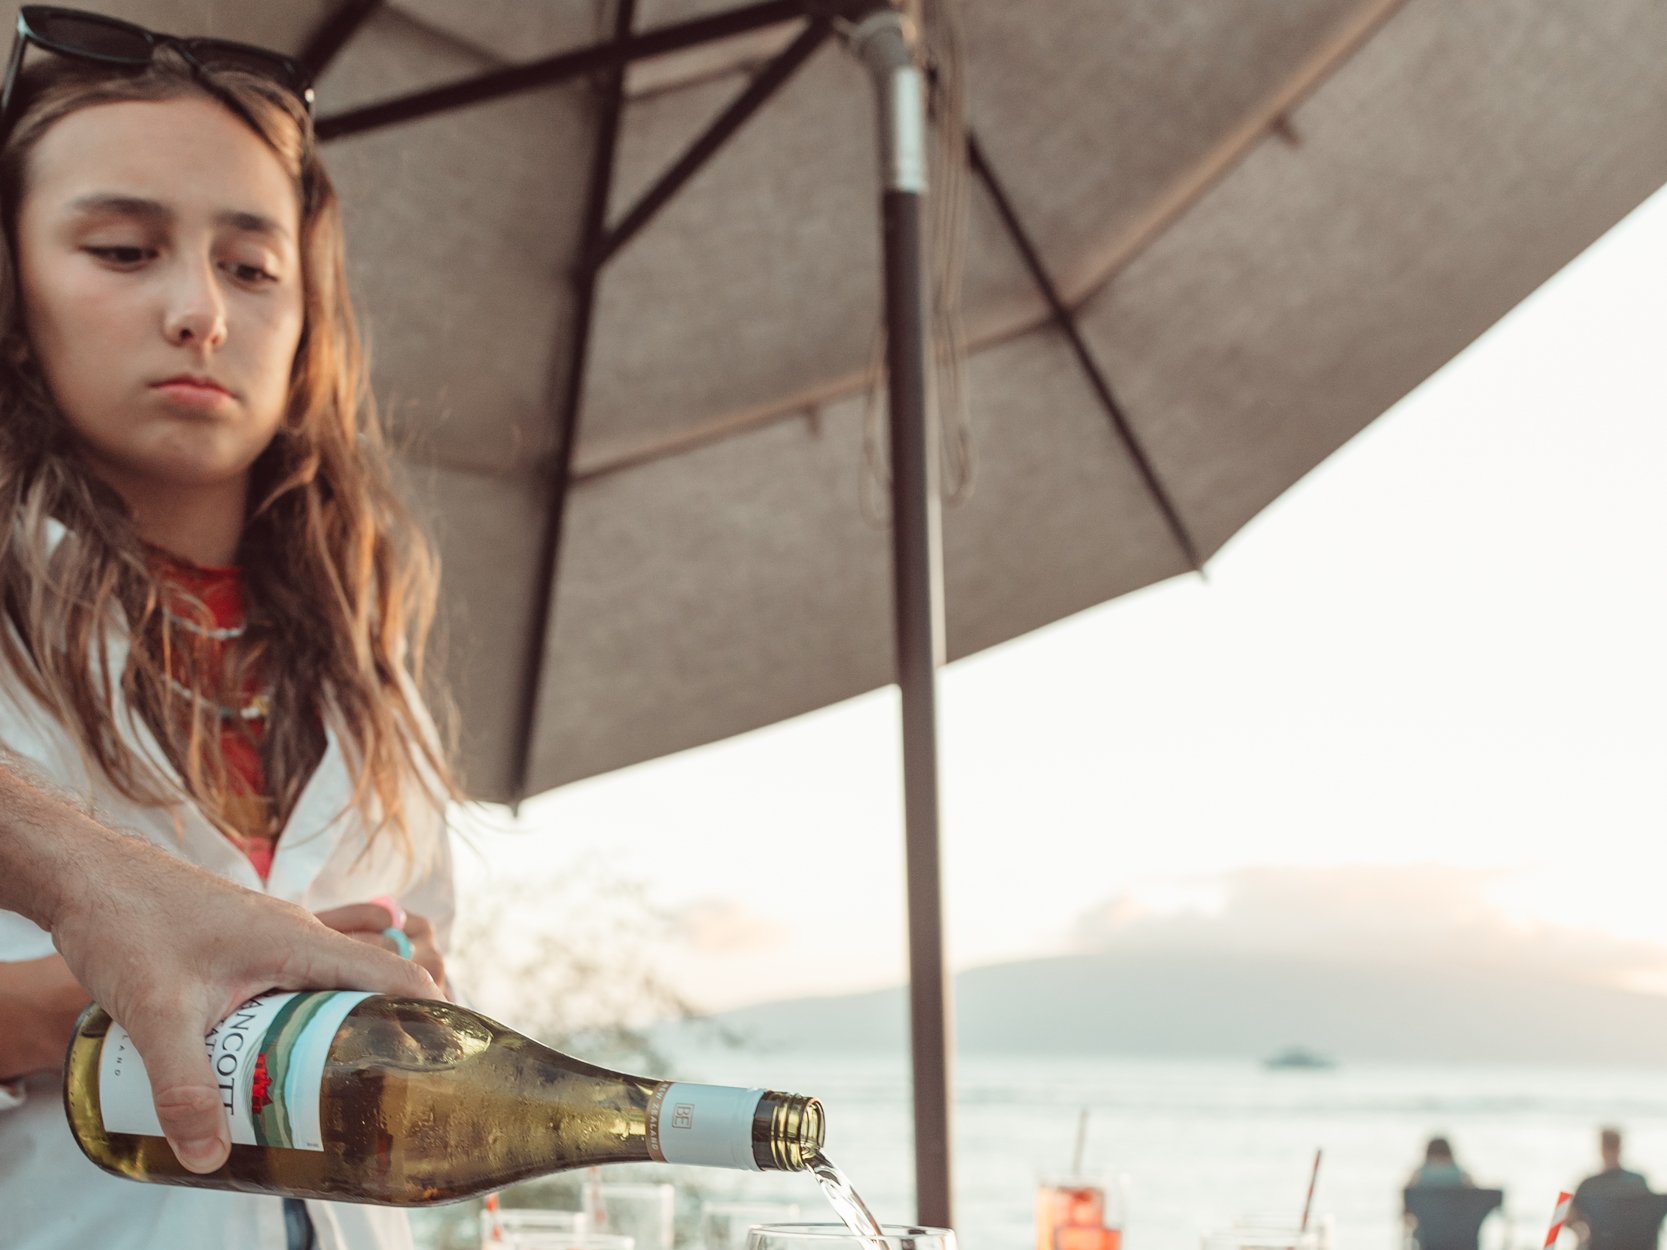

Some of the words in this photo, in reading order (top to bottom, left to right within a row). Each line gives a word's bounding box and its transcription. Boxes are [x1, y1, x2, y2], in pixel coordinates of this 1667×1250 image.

[113, 1034, 127, 1077] LAND
[215, 996, 266, 1116] ANCOTT
[649, 1103, 659, 1149] ZEALAND
